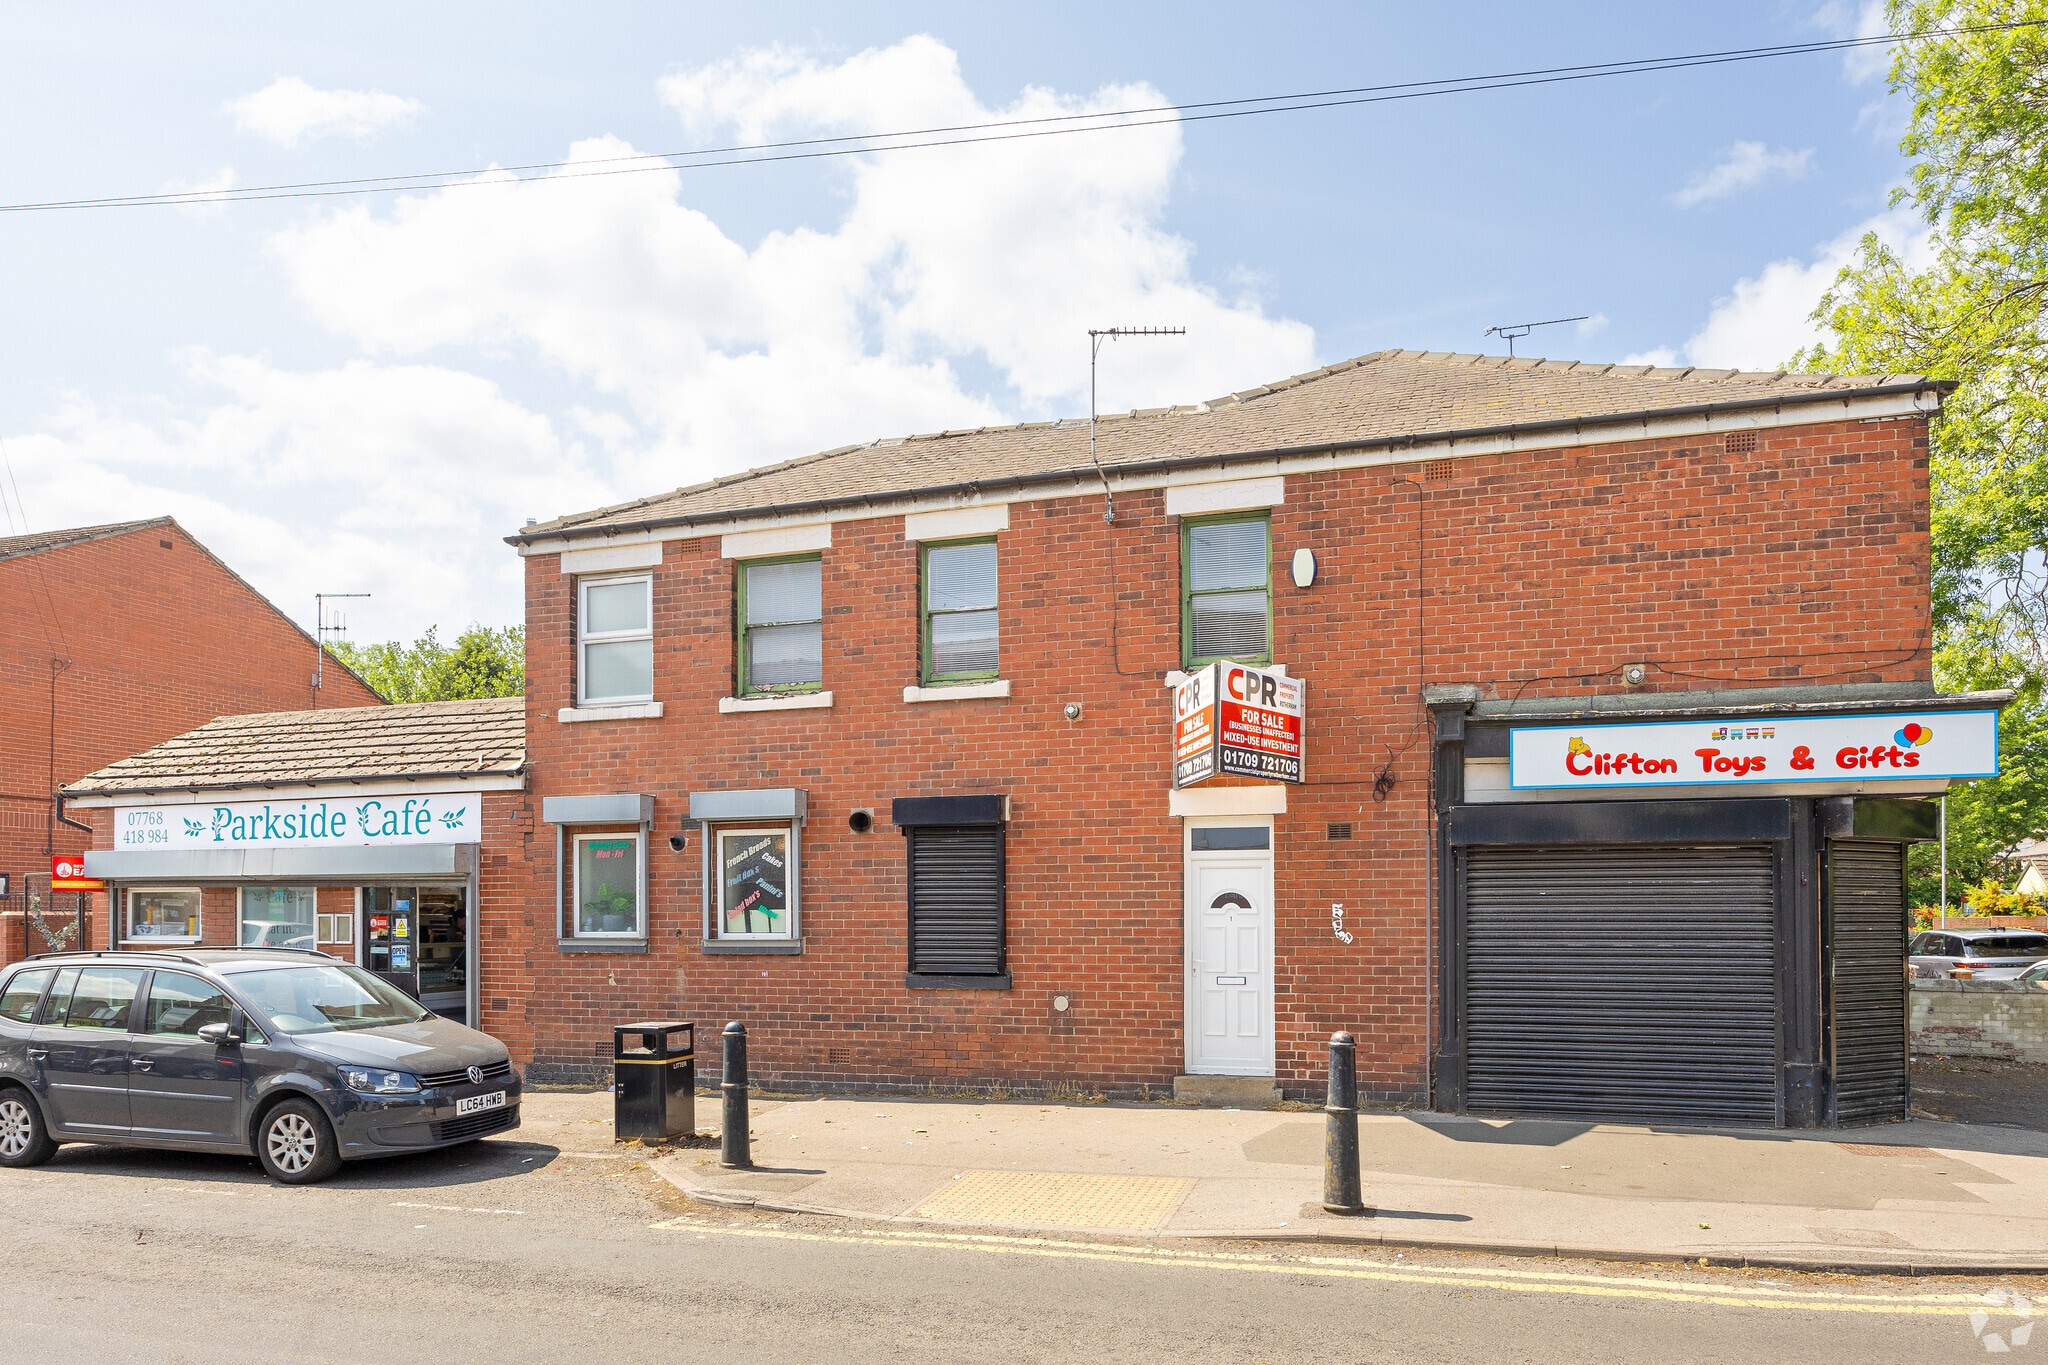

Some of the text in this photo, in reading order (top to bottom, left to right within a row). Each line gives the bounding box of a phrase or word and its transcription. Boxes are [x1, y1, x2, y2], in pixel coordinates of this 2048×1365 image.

[1178, 678, 1200, 716] CPR
[1228, 668, 1277, 707] CPR
[1241, 708, 1284, 729] FOR SALE
[1229, 720, 1294, 741] (BUSINESSES UNAFFECTED)
[1223, 731, 1260, 746] MIXED-USE
[1261, 738, 1298, 753] INVESTMENT
[1193, 753, 1212, 772] 721706
[1223, 750, 1298, 774] 01709 721706
[1565, 745, 1921, 777] Clifton Toys & Gifts
[127, 811, 164, 826] 07768
[211, 798, 432, 842] Parkside Café
[123, 828, 169, 844] 418 984
[596, 850, 610, 858] Mon
[614, 850, 624, 858] Fri
[726, 837, 772, 869] French Breads
[761, 852, 783, 868] Cakes
[727, 873, 742, 888] Fruit
[755, 877, 784, 898] Panini's
[744, 889, 761, 907] box's
[392, 947, 406, 955] OPEN
[673, 1061, 687, 1069] LITTER
[460, 1093, 502, 1112] LC64 HWB
